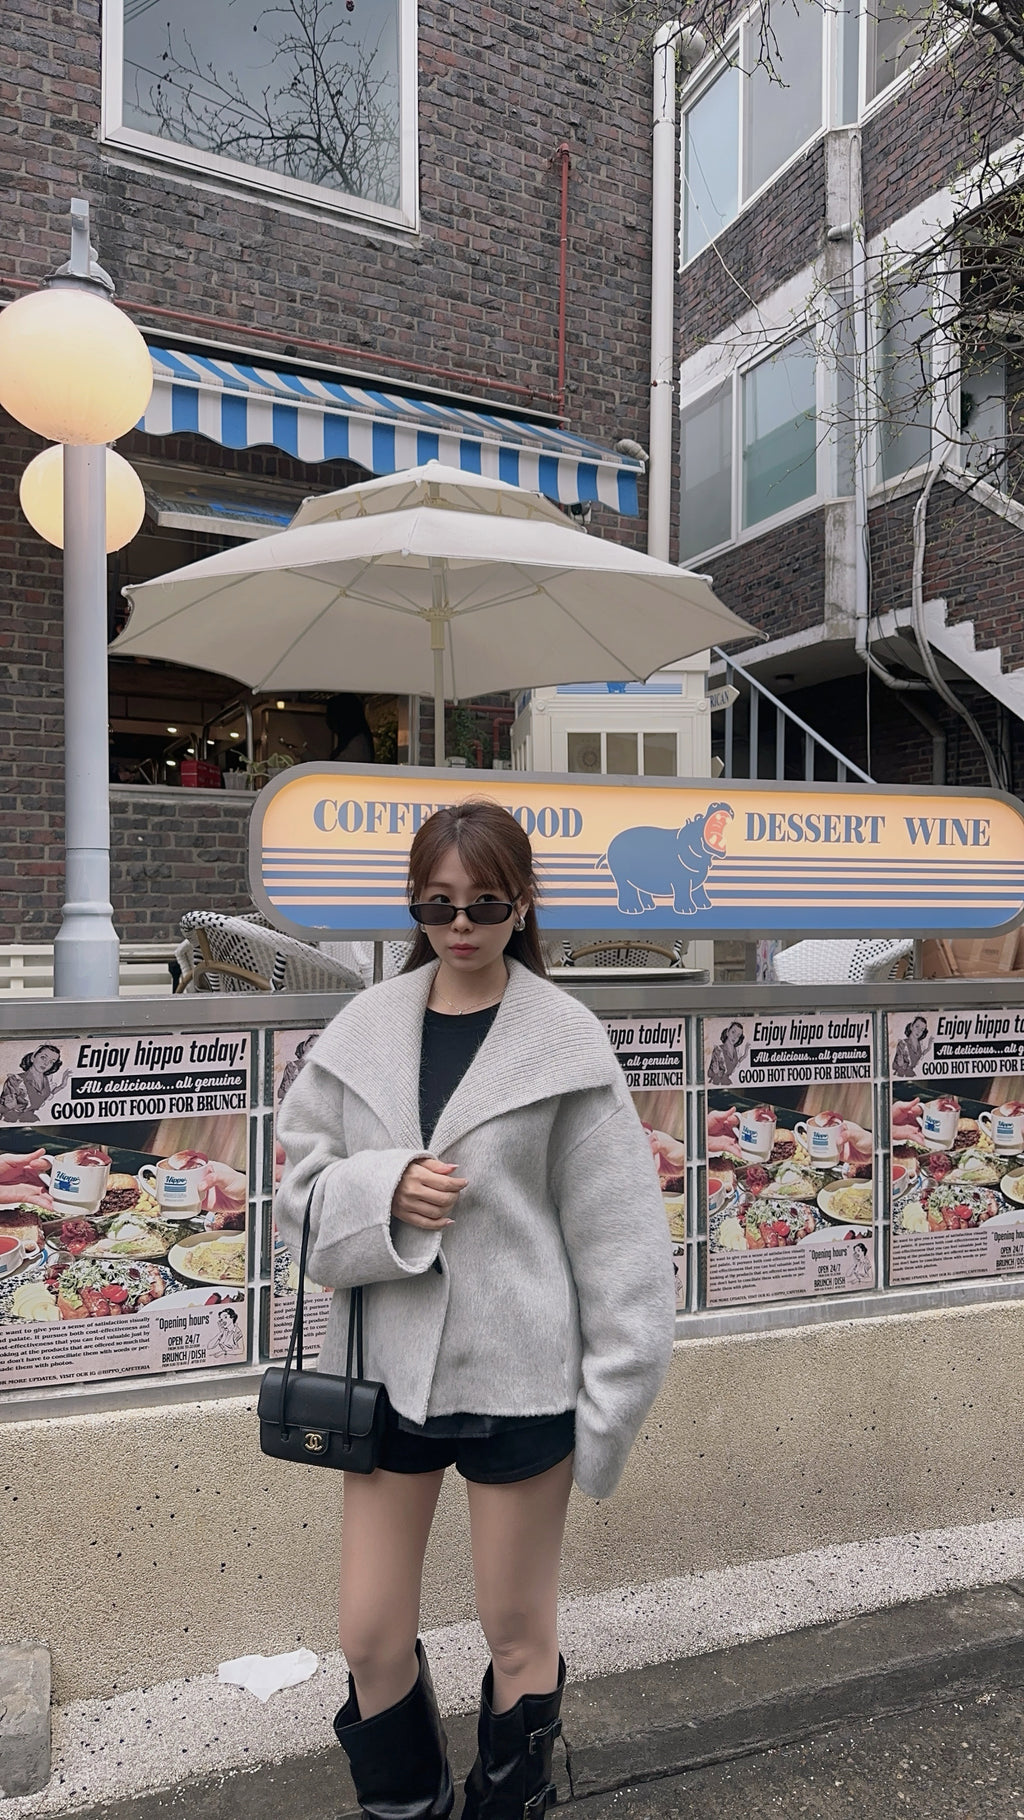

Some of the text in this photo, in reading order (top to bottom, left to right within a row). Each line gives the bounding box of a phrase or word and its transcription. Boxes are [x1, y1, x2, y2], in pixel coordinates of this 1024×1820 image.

[707, 690, 729, 708] RICAN
[314, 799, 991, 847] COFFE OOD DESSERT WINE
[753, 1017, 870, 1046] Enjoy hippo today!
[937, 1015, 972, 1040] Enjoy
[974, 1014, 1010, 1039] hippo
[608, 1022, 682, 1050] ippo today!
[77, 1037, 247, 1073] Enjoy hippo today!
[753, 1052, 769, 1063] All
[832, 1049, 867, 1063] genuine
[936, 1045, 953, 1056] All
[642, 1054, 680, 1070] genuine
[922, 1061, 949, 1075] GOOD
[951, 1061, 970, 1074] HOT
[972, 1060, 997, 1073] FOOD
[999, 1059, 1018, 1072] FOR
[625, 1072, 683, 1087] OR BRUNCH
[739, 1065, 871, 1083] GOOD HOT FOOD FOR BRUNCH
[76, 1080, 102, 1094] All
[193, 1074, 242, 1092] genuine
[51, 1093, 246, 1120] GOOD HOT FOOD FOR BRUNCH
[56, 1171, 80, 1184] Hippo
[165, 1175, 187, 1184] Hippo
[1001, 1246, 1011, 1254] OPEN
[818, 1264, 841, 1273] OPEN 24/7
[168, 1334, 200, 1346] OPEN 24/7
